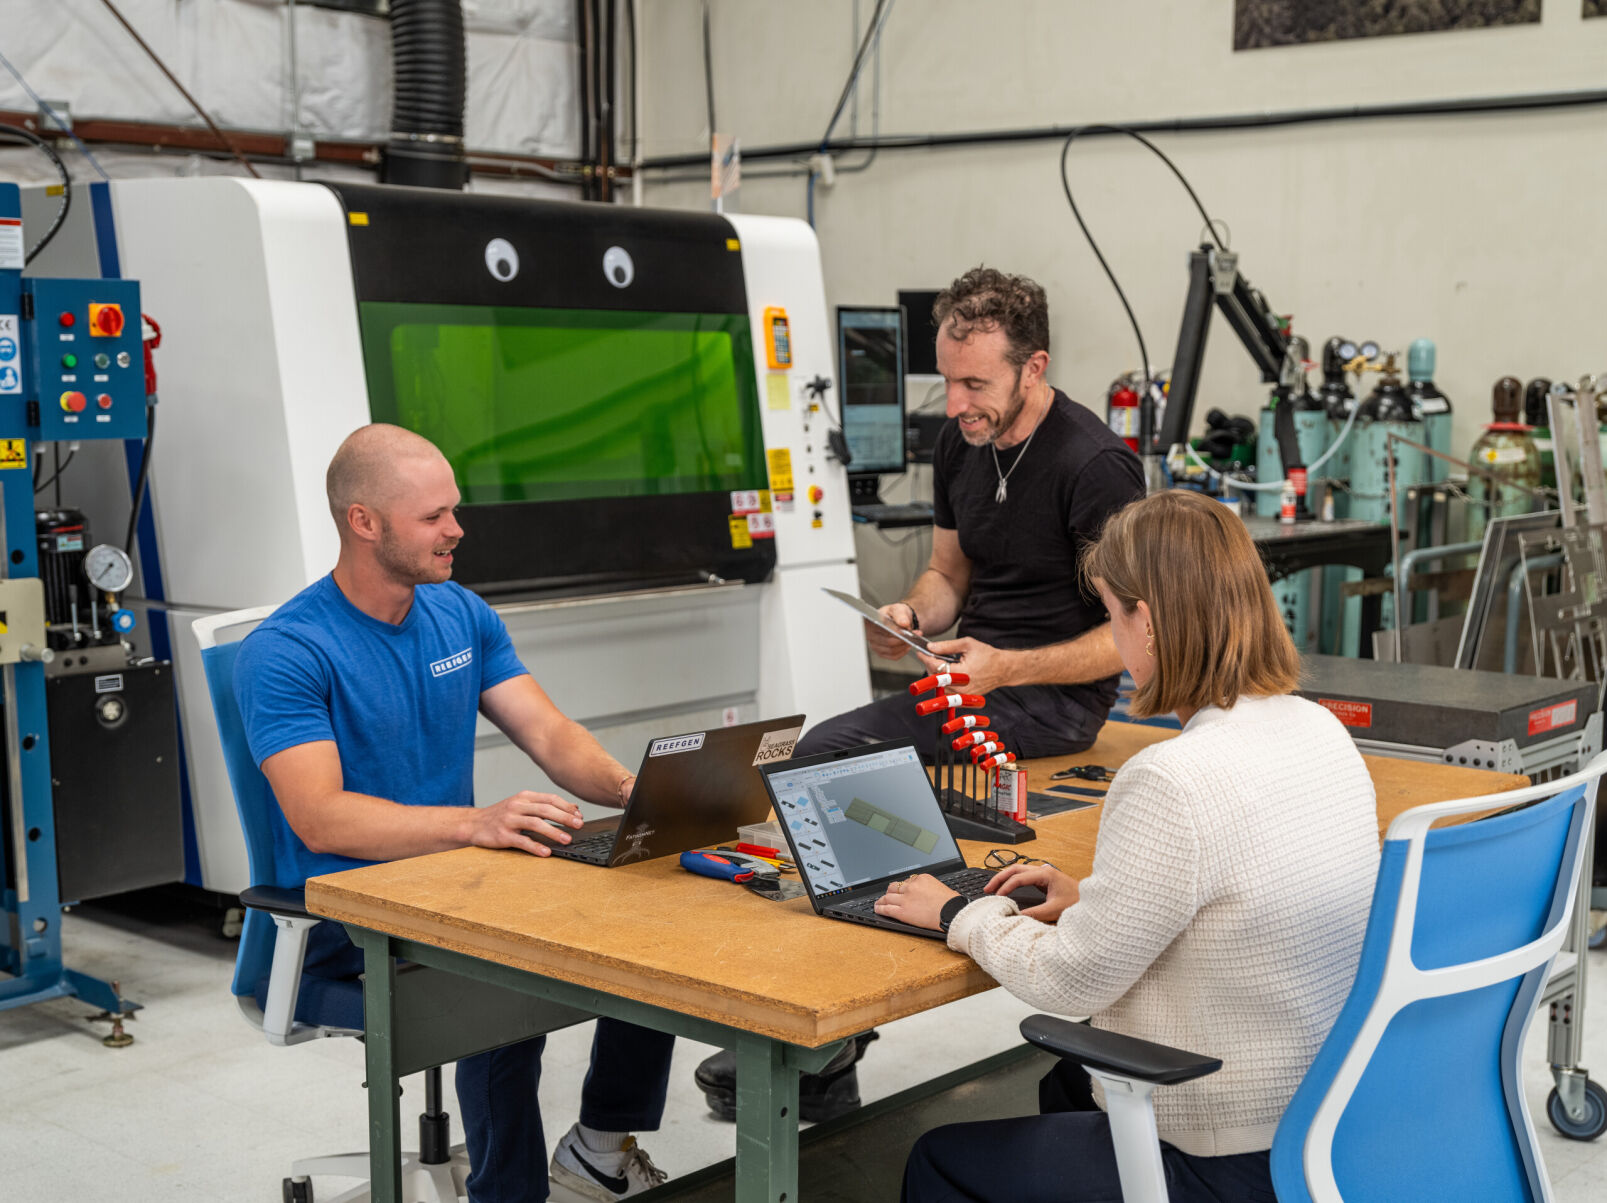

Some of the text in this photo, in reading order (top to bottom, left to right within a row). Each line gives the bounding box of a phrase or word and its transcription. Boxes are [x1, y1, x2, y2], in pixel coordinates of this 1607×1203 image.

[1320, 701, 1369, 713] PRECISION
[656, 738, 700, 751] REEFGEN
[767, 739, 796, 749] SEAGRASS
[755, 745, 793, 762] ROCKS
